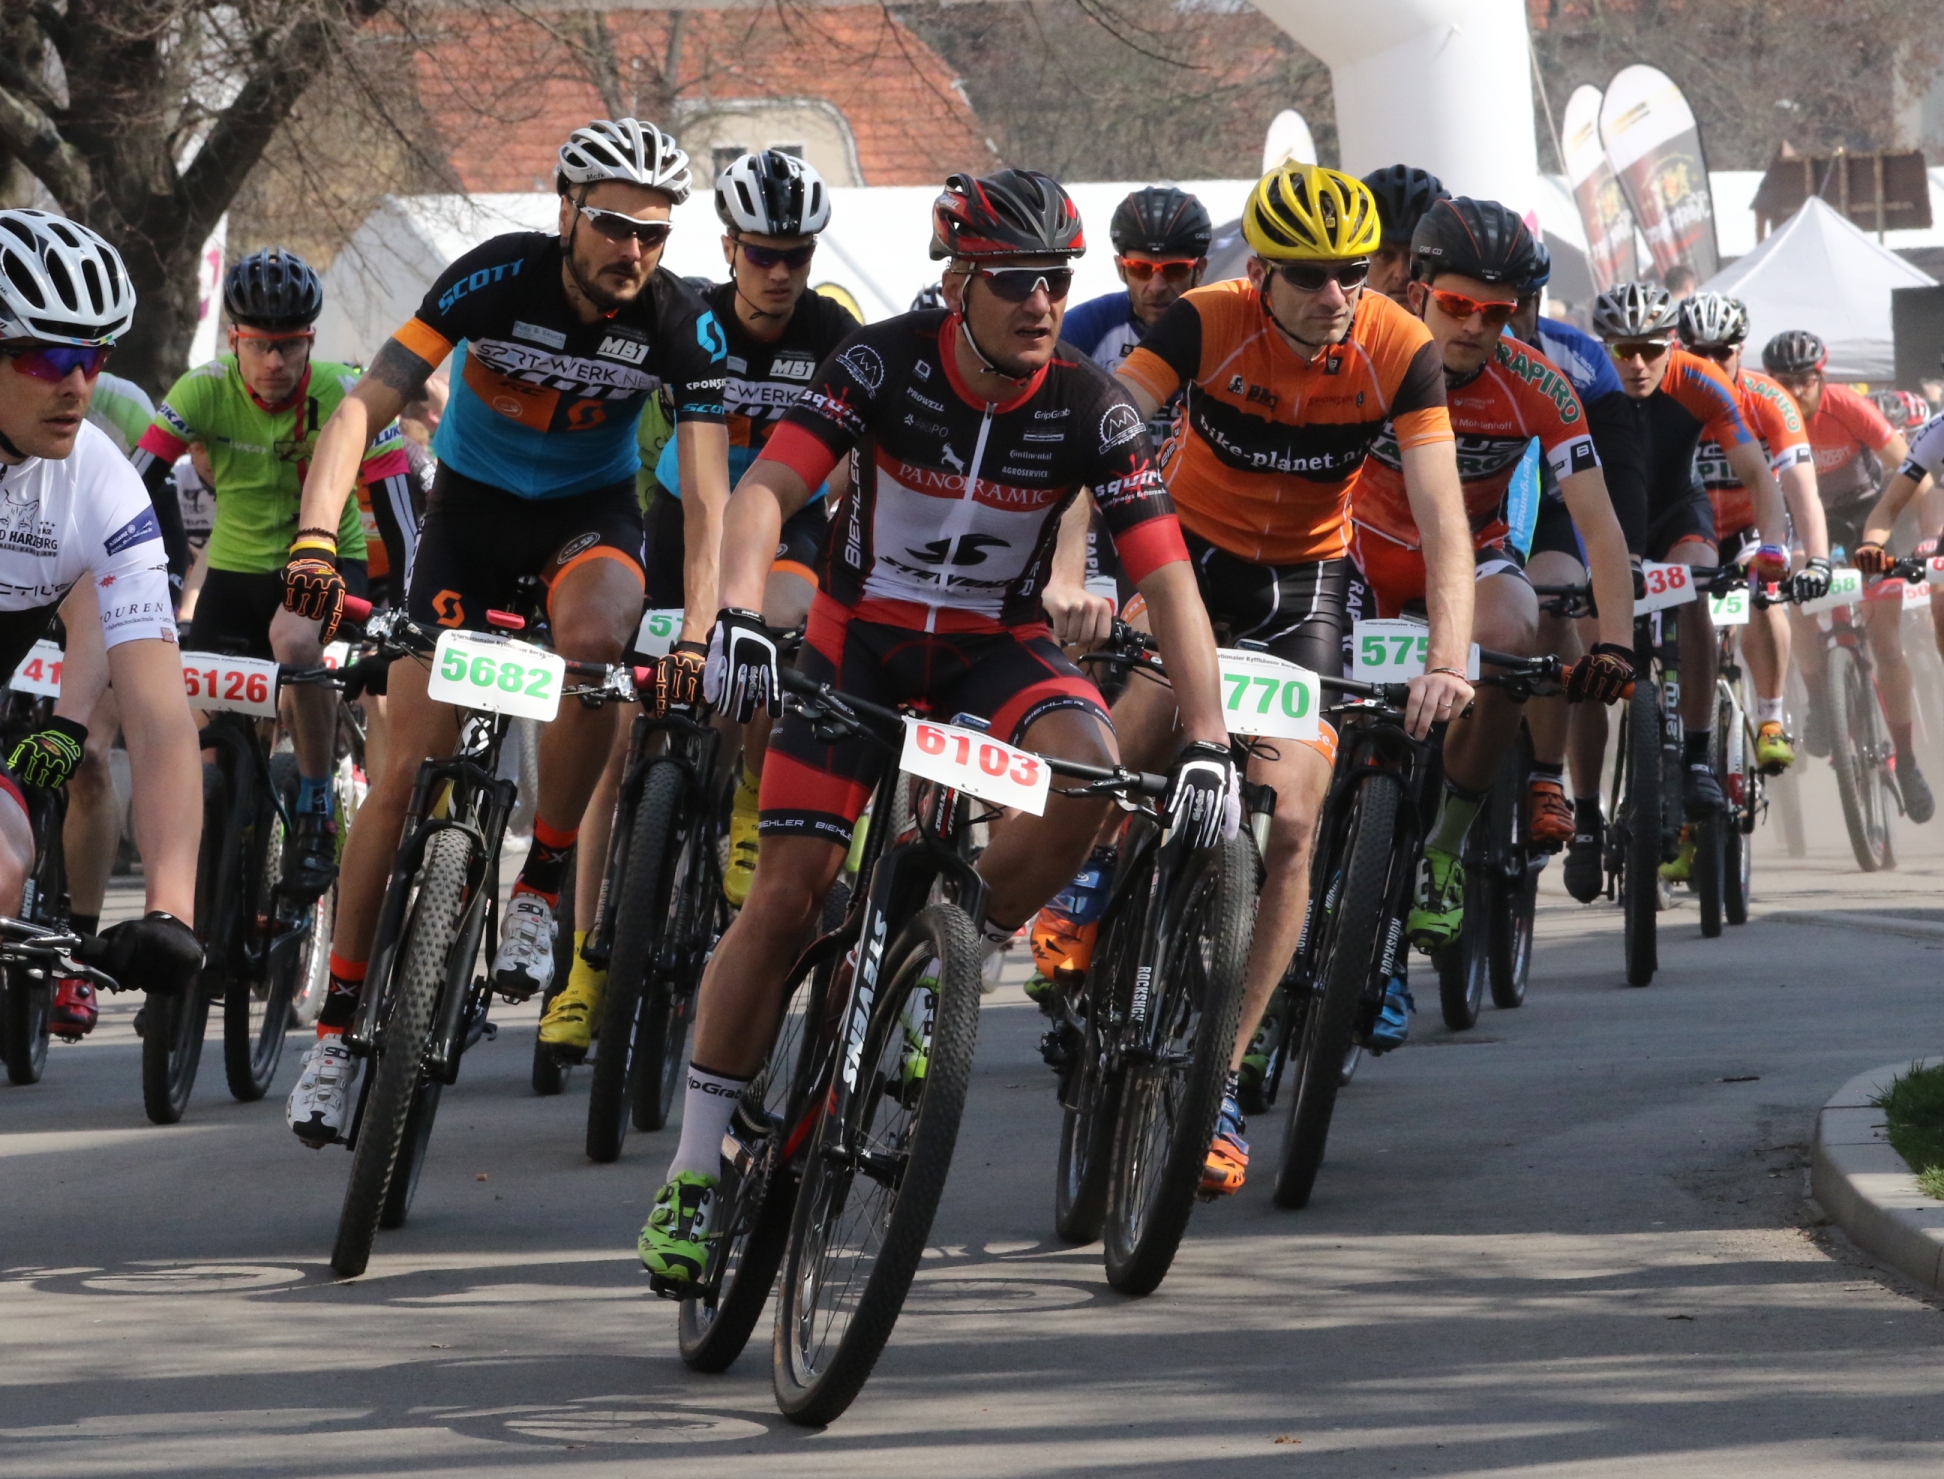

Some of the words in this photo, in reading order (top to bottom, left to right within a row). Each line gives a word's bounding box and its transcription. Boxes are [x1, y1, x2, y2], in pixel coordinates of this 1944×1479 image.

[438, 258, 524, 316] SCOTT
[906, 386, 945, 413] PROWELL
[1493, 341, 1581, 424] RAPIRO
[1034, 407, 1071, 421] GripGrab
[1001, 465, 1048, 478] AGROSERVICE
[1009, 449, 1052, 461] Continental
[898, 463, 1054, 505] PANORAMIC
[1094, 468, 1164, 498] squirt
[1514, 454, 1533, 539] bergamont
[844, 447, 862, 571] BIEHLER
[1644, 566, 1687, 595] 38
[182, 666, 268, 704] 6126
[440, 646, 553, 701] 5682
[1223, 673, 1310, 719] 770
[915, 724, 1039, 788] 6103
[517, 903, 544, 918] SIDI
[1379, 917, 1402, 976] ROCKSHOX
[842, 909, 888, 1094] STEVENS
